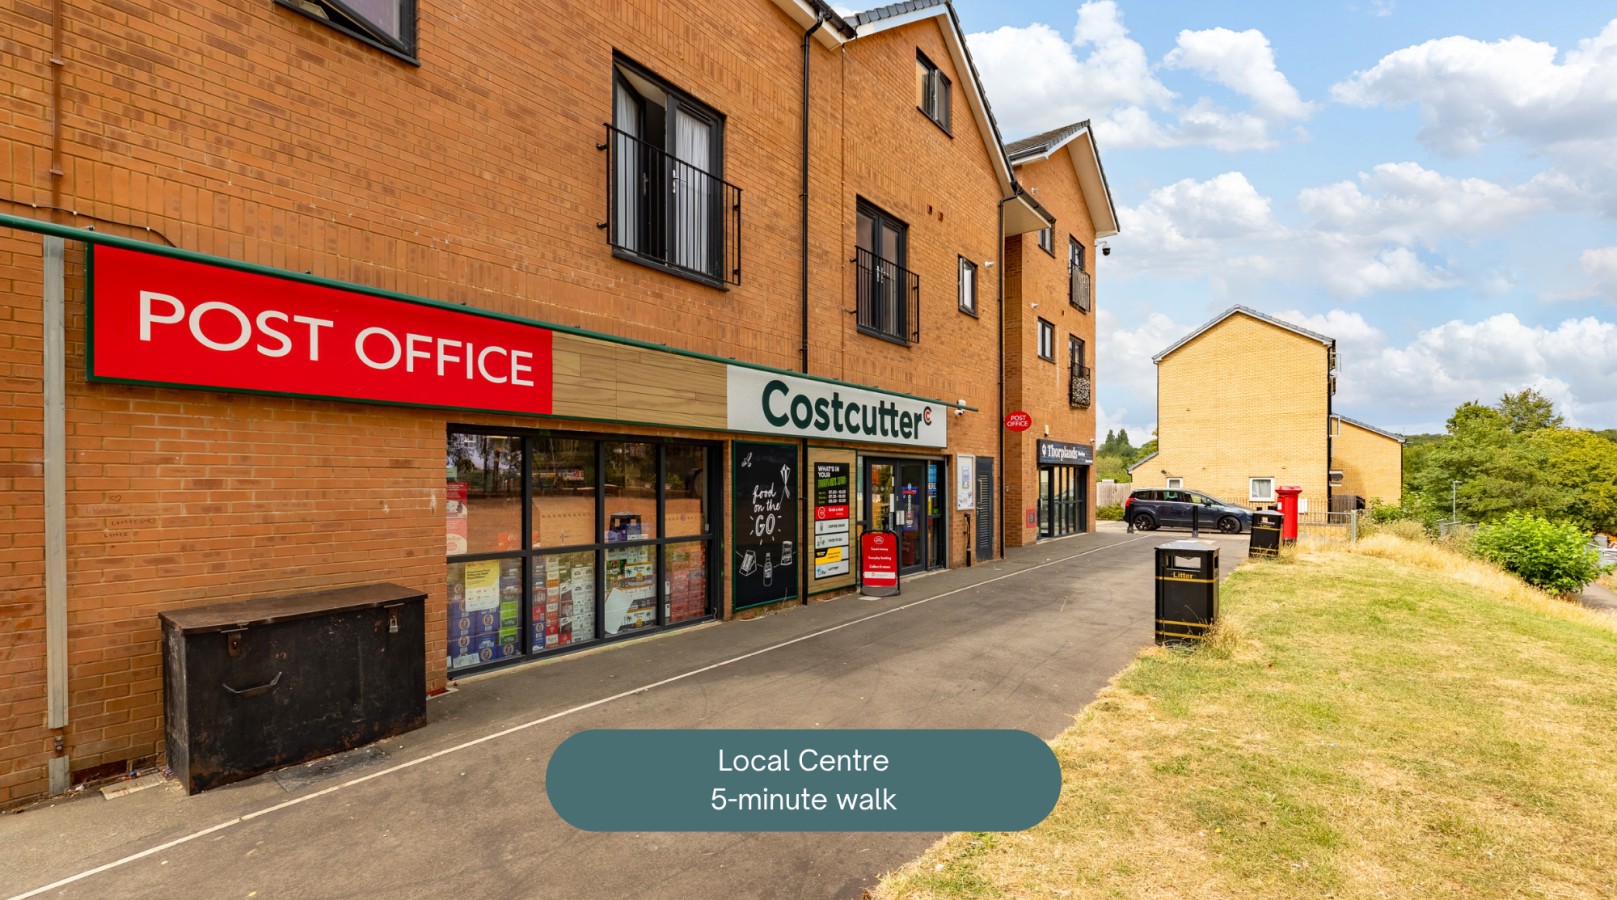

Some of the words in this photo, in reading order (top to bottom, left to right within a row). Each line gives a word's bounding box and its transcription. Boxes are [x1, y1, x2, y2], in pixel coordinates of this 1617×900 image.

[139, 290, 334, 361] POST
[355, 326, 534, 386] OFFICE
[762, 380, 922, 439] Costcutter
[1047, 444, 1078, 461] Thorplands
[752, 482, 777, 505] food
[754, 503, 765, 513] on
[766, 499, 780, 512] the
[755, 513, 776, 537] GO
[1173, 571, 1194, 579] Litter
